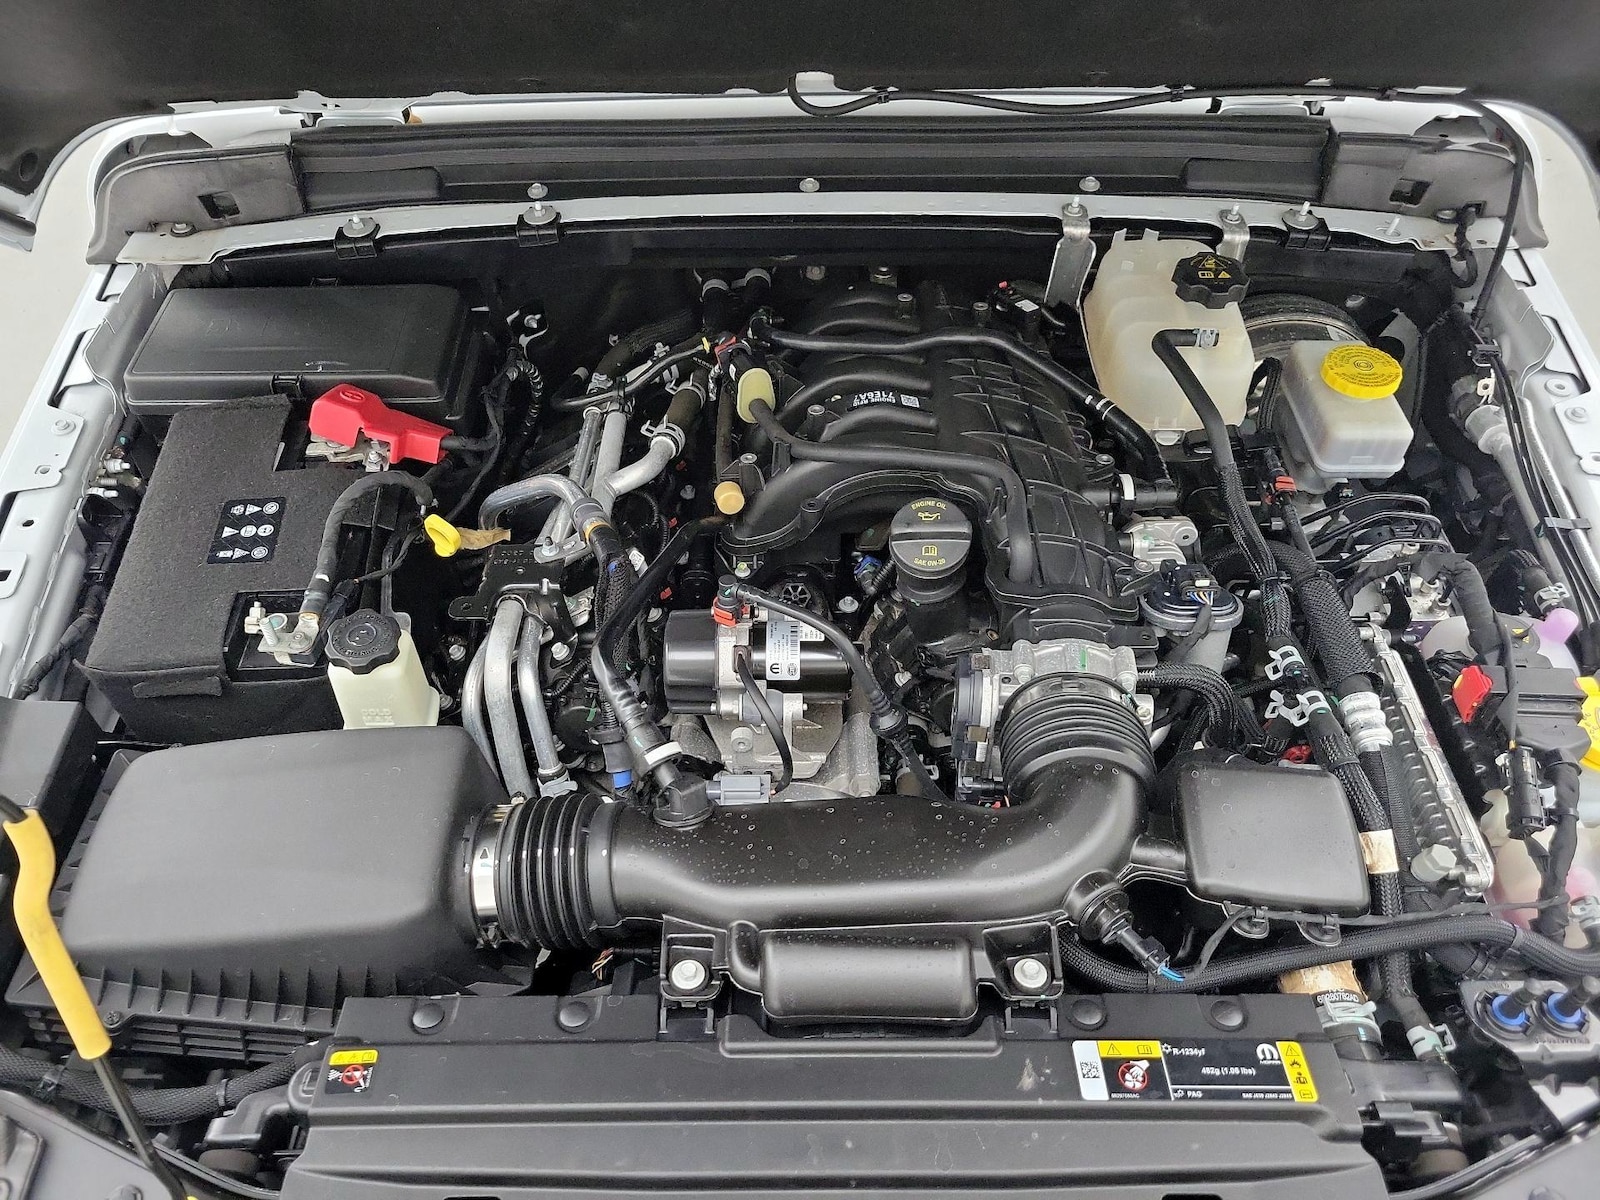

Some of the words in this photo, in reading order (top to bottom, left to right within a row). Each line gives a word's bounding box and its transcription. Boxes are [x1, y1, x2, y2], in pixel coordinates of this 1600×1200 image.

[911, 501, 936, 510] ENGINE
[936, 502, 947, 510] OIL
[914, 557, 927, 566] SAE
[927, 558, 946, 566] 0W-20
[1172, 1047, 1206, 1057] R-1234yf
[1240, 1066, 1257, 1077] lbs)
[1187, 1090, 1203, 1098] PAG
